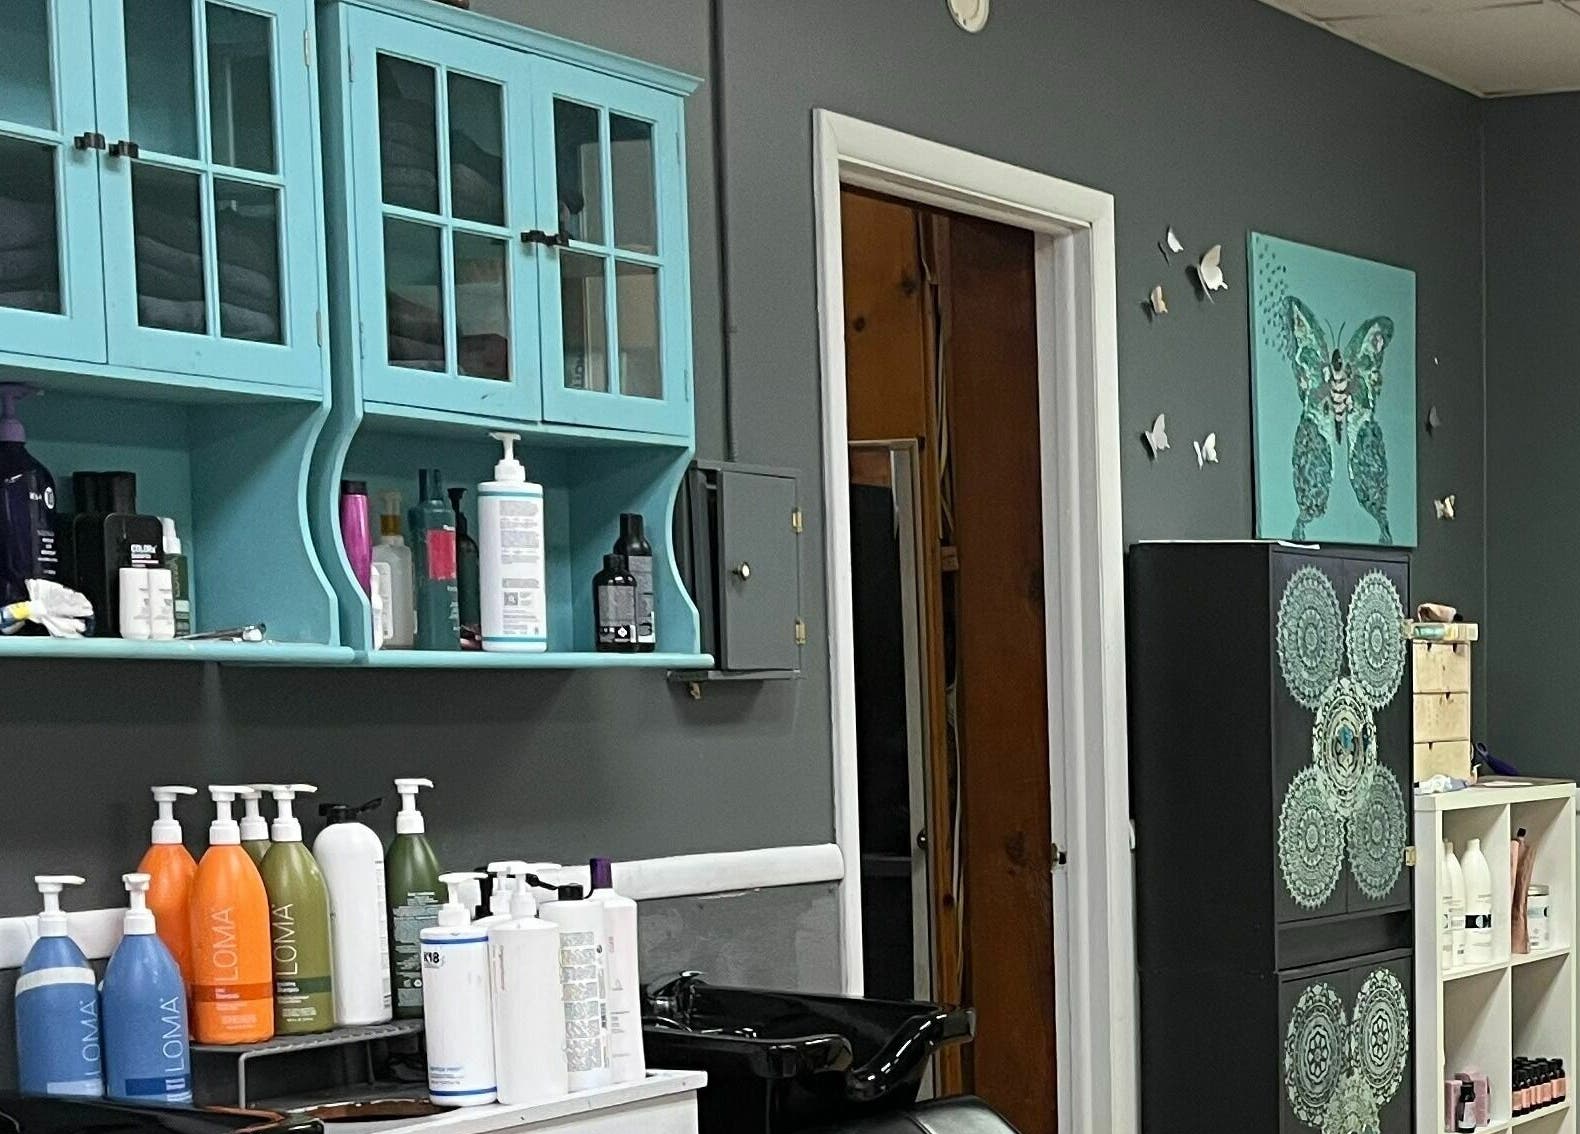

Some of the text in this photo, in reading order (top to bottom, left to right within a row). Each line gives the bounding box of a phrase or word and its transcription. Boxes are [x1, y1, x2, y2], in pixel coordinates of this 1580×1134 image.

[211, 907, 239, 982] LOMA
[272, 903, 298, 975] LOMA
[424, 952, 440, 964] K18
[160, 996, 185, 1072] LOMA
